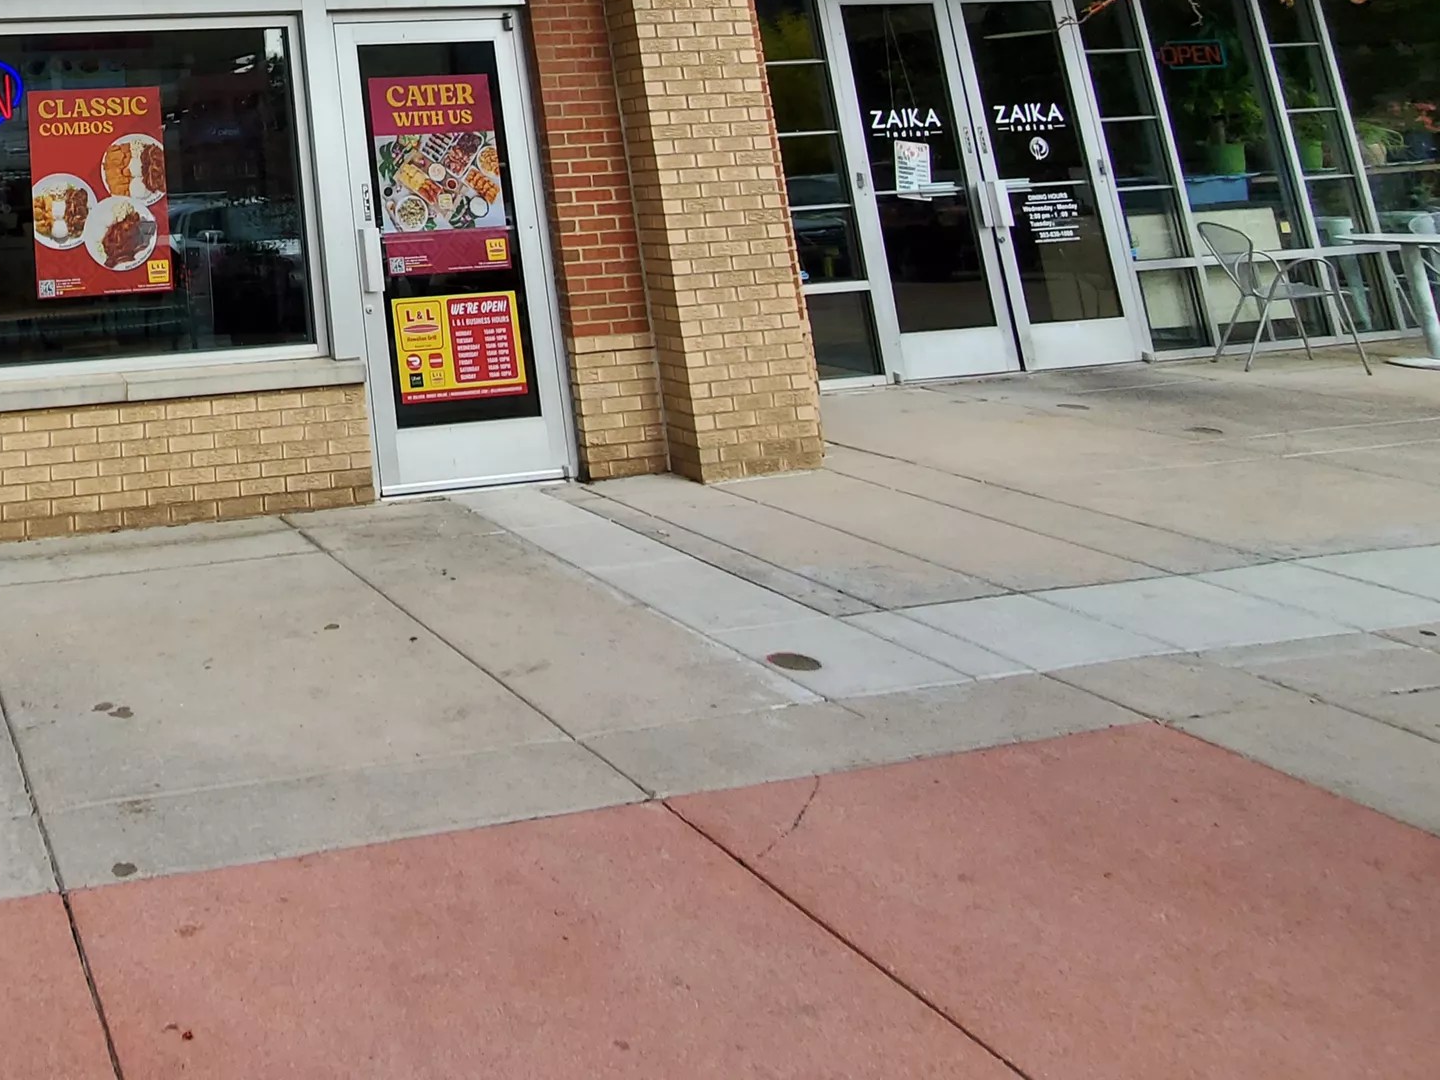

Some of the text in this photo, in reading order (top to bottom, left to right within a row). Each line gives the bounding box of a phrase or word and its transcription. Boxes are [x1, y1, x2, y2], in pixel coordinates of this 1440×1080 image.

[1160, 44, 1221, 64] OPEN
[386, 83, 474, 107] CATER
[37, 95, 147, 119] CLASSIC
[993, 102, 1064, 123] ZAIKA
[392, 109, 472, 126] WITH US
[869, 107, 942, 129] ZAIKA
[39, 120, 114, 136] COMBOS
[451, 300, 506, 315] WE'RE OPEN!
[465, 317, 490, 325] BUSINESS
[491, 315, 509, 323] HOURS
